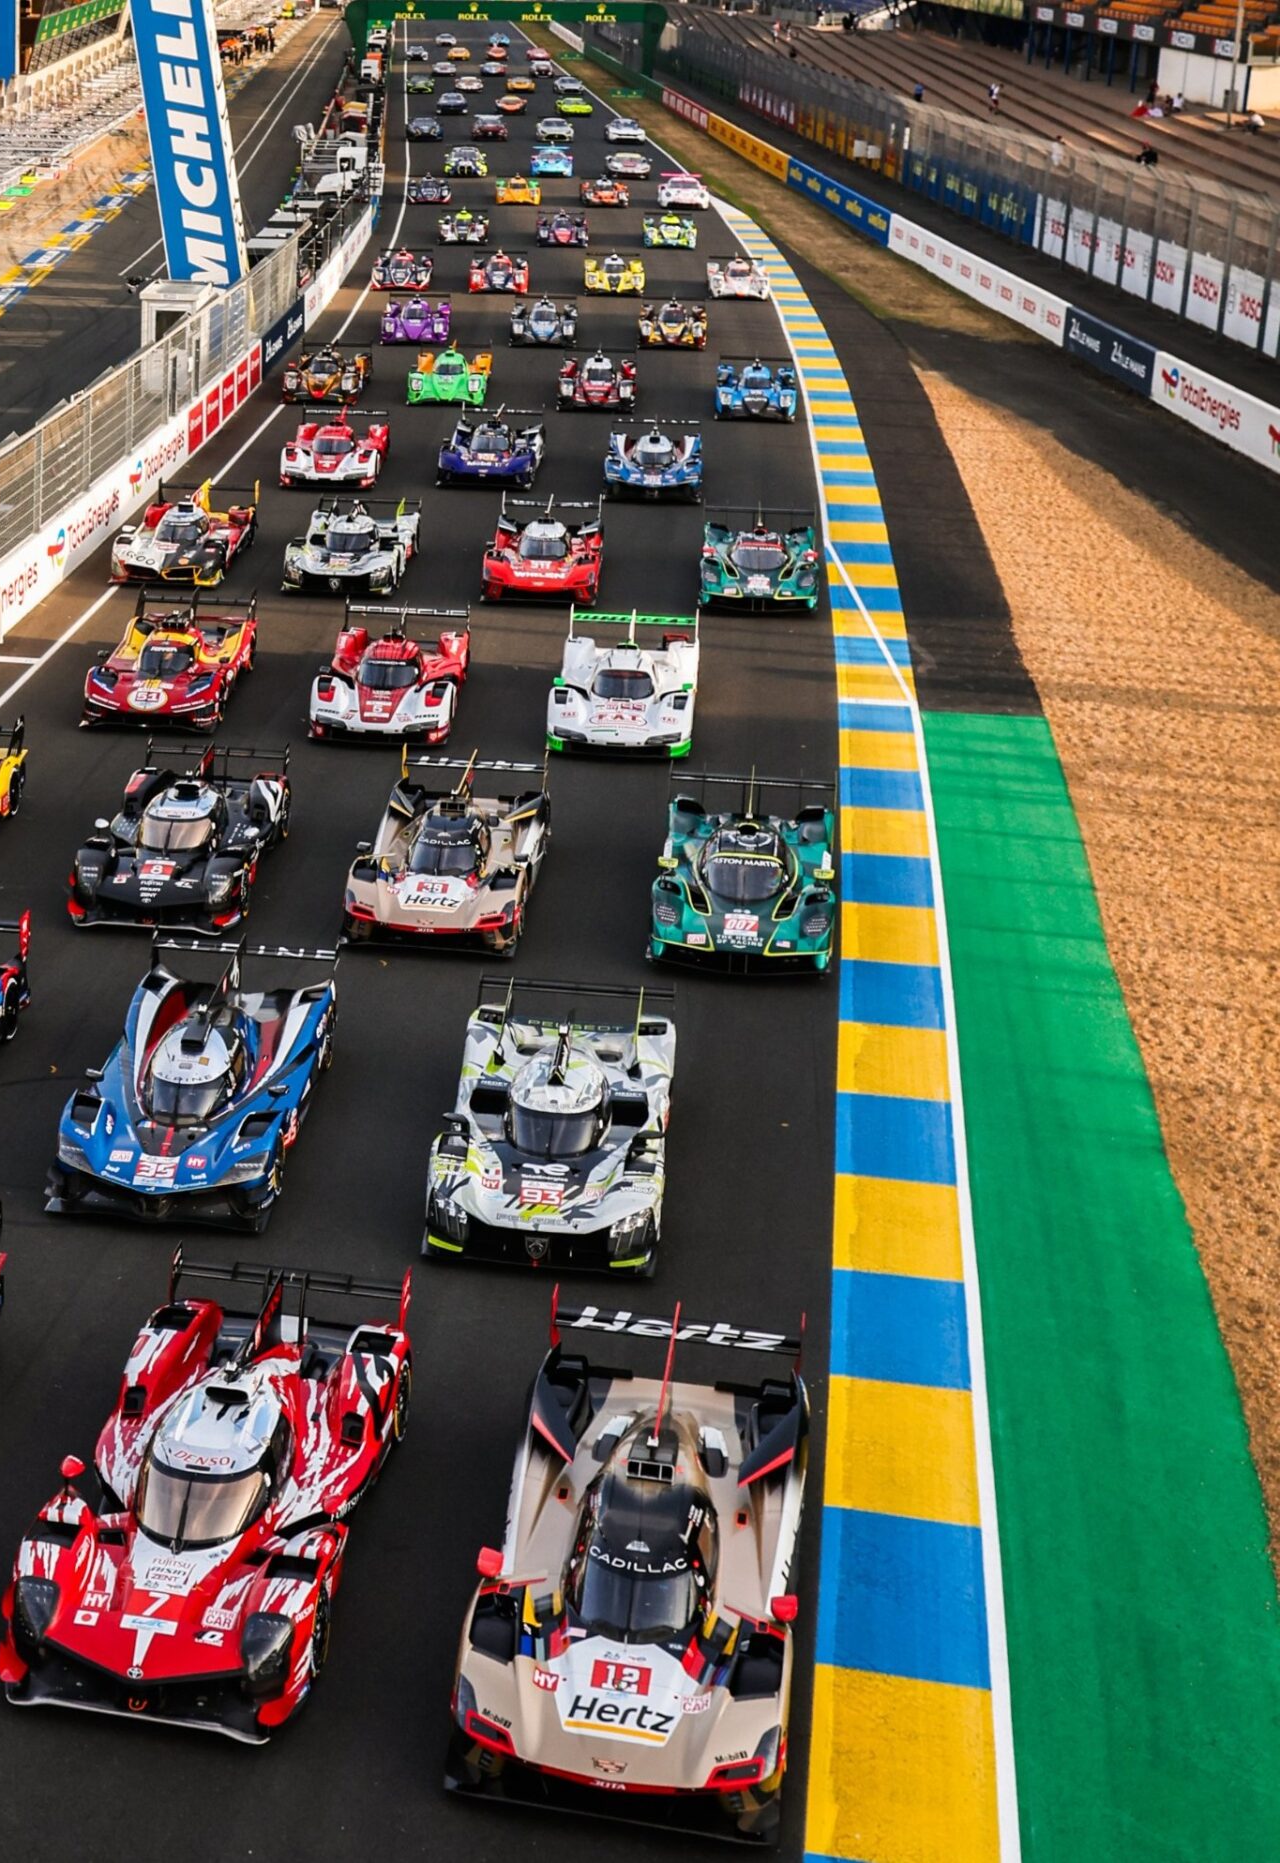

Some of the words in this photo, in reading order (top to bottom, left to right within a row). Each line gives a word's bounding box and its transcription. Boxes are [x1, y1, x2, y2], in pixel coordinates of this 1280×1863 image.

[586, 14, 616, 22] ROLEX
[1154, 260, 1175, 284] OSCH
[1193, 274, 1220, 303] BOSCH
[1180, 376, 1241, 430] TotalEnergies
[144, 428, 185, 480] TotalEnergies
[68, 488, 120, 549] TotalEnergies
[418, 836, 471, 846] CADILLAC
[150, 864, 163, 875] 8
[405, 893, 460, 908] Hertz
[725, 919, 756, 930] 007
[528, 1018, 624, 1032] PEGEOT
[187, 1157, 206, 1167] HY
[137, 1165, 176, 1178] 35
[481, 1179, 498, 1188] HY
[521, 1189, 561, 1205] 93
[571, 1306, 786, 1350] Hertz
[174, 1450, 231, 1466] DENSO
[152, 1558, 193, 1569] FUJITSU
[589, 1545, 688, 1574] CADILLAC
[151, 1573, 178, 1582] ZENT
[86, 1593, 108, 1607] HY
[142, 1591, 171, 1616] 7
[205, 1614, 232, 1628] CAR
[534, 1669, 558, 1690] HY
[601, 1664, 640, 1693] 12
[682, 1700, 710, 1713] CAR
[568, 1694, 674, 1734] Hertz
[589, 1778, 626, 1791] JOTA
